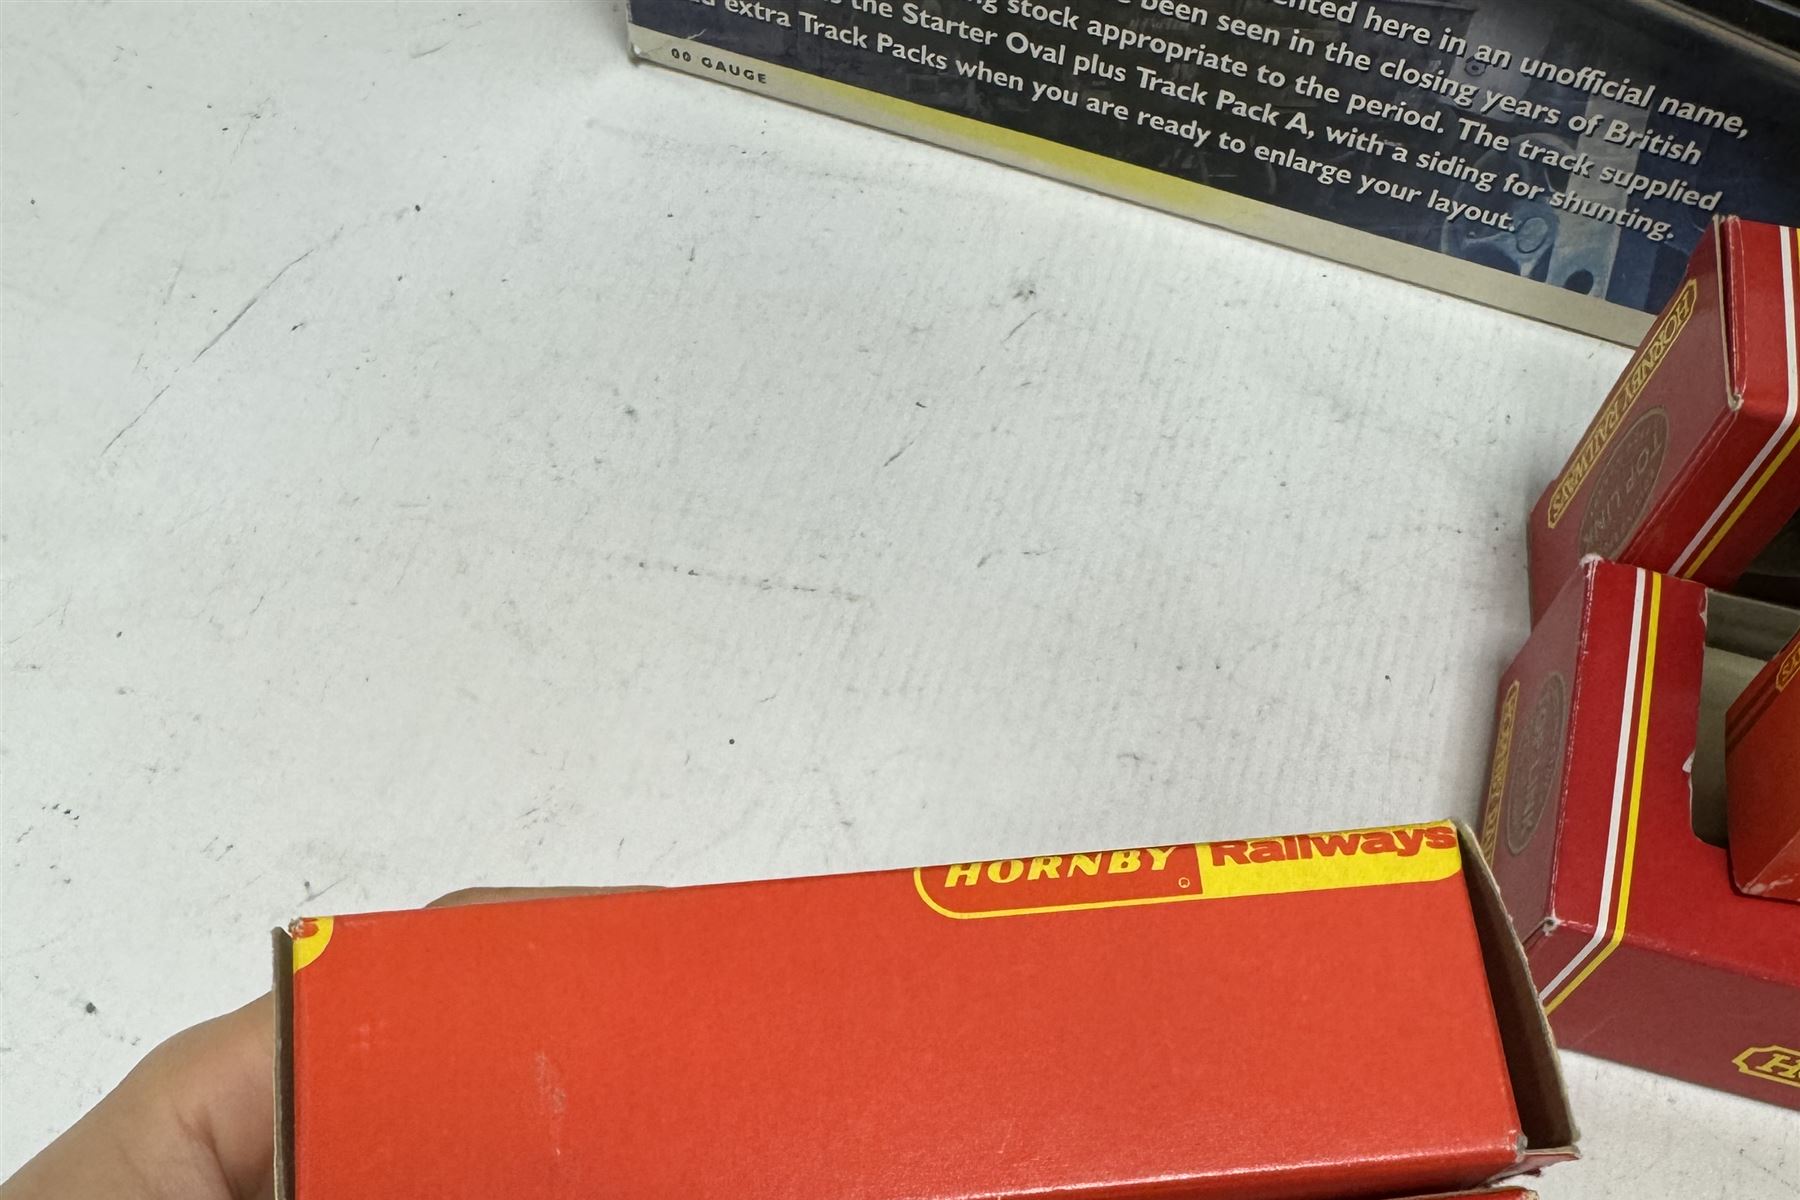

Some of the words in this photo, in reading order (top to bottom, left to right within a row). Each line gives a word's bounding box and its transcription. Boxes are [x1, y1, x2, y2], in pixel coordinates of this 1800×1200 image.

[702, 57, 767, 84] GAUGE
[724, 0, 791, 27] extra
[798, 11, 868, 49] Track
[877, 32, 948, 70] Packs
[955, 59, 1023, 91] when
[1031, 81, 1079, 107] you
[1086, 97, 1129, 120] are
[1137, 110, 1211, 148] ready
[1218, 132, 1246, 154] to
[1254, 145, 1352, 186] enlarge
[1357, 175, 1422, 202] your
[1427, 189, 1516, 232] layout.
[902, 2, 998, 45] Starter
[1006, 31, 1066, 65] Oval
[1073, 53, 1126, 82] plus
[1136, 65, 1208, 106] Track
[1215, 89, 1280, 126] Pack
[1284, 111, 1315, 140] A,
[1326, 126, 1384, 155] with
[1391, 146, 1408, 163] a
[1416, 151, 1497, 193] siding
[1503, 173, 1545, 200] for
[1549, 190, 1675, 242] shunting.
[1007, 0, 1080, 31] stock
[1087, 19, 1247, 77] appropriate
[1257, 64, 1286, 88] to
[1294, 75, 1340, 104] the
[1346, 93, 1444, 134] period.
[1458, 117, 1510, 151] The
[1518, 139, 1595, 176] track
[1600, 165, 1723, 211] supplied
[1216, 14, 1280, 46] seen
[1288, 29, 1315, 56] in
[1325, 42, 1371, 71] the
[1380, 58, 1480, 107] closing
[1480, 90, 1561, 125] years
[1568, 113, 1604, 137] of
[1603, 119, 1701, 165] British
[1363, 6, 1431, 45] here
[1438, 27, 1467, 56] in
[1473, 44, 1512, 69] an
[1519, 56, 1656, 108] unofficial
[1658, 96, 1748, 139] name,
[1623, 292, 1690, 406] HORNBY
[1552, 400, 1620, 517] RAILWAYS
[944, 846, 1177, 888] HORNBY
[1210, 825, 1458, 867] Railways
